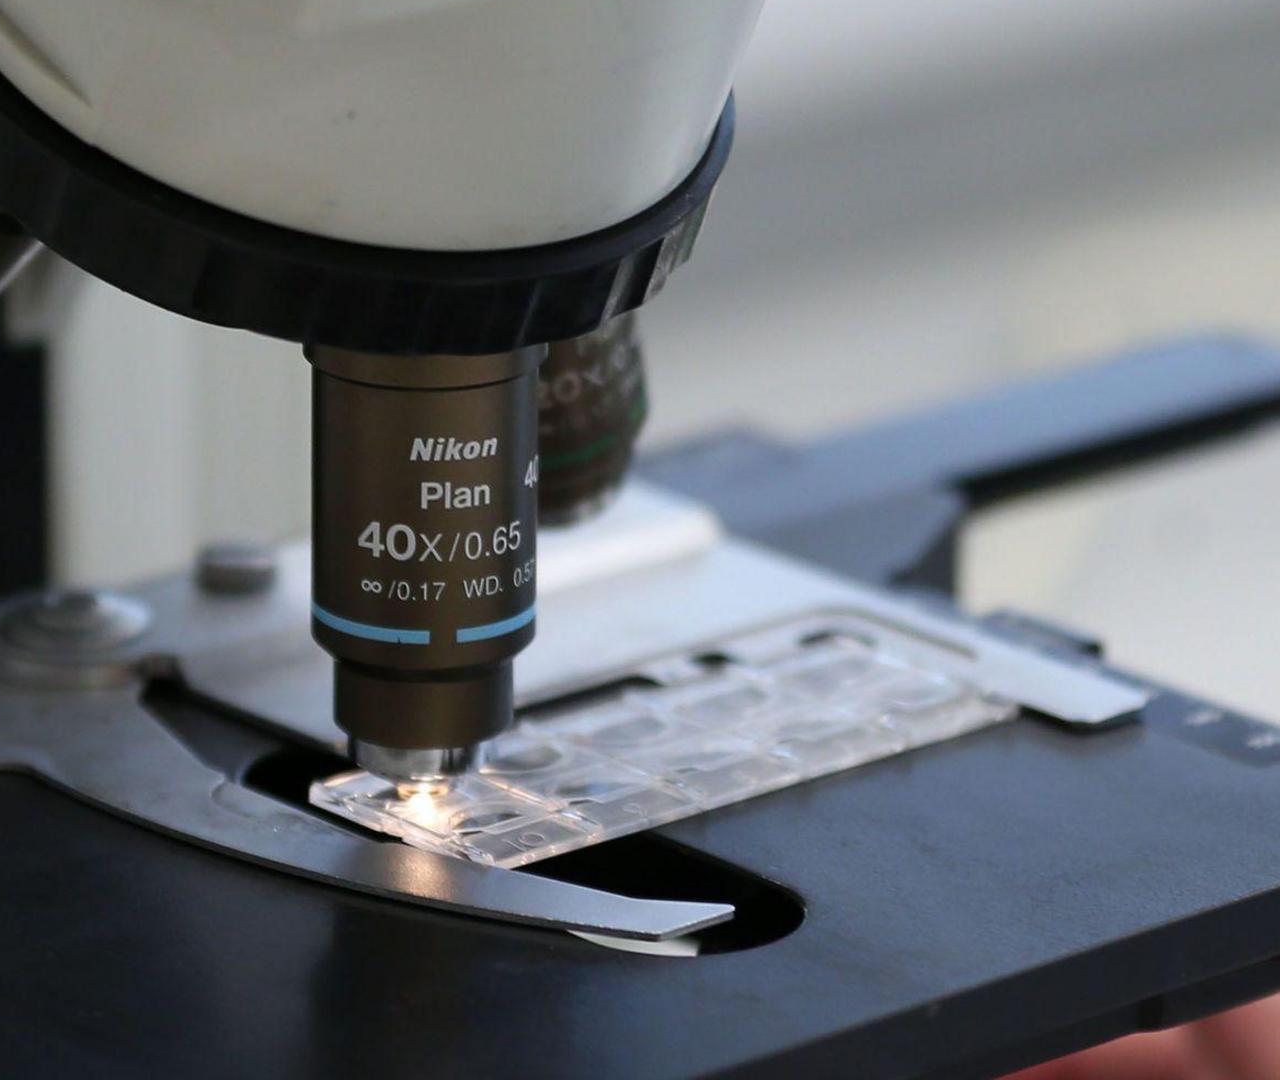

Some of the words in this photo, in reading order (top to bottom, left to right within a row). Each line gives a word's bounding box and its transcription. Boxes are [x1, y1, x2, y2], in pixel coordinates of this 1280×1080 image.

[409, 436, 498, 462] Nikon
[419, 481, 491, 510] Plan
[463, 575, 504, 600] WD.
